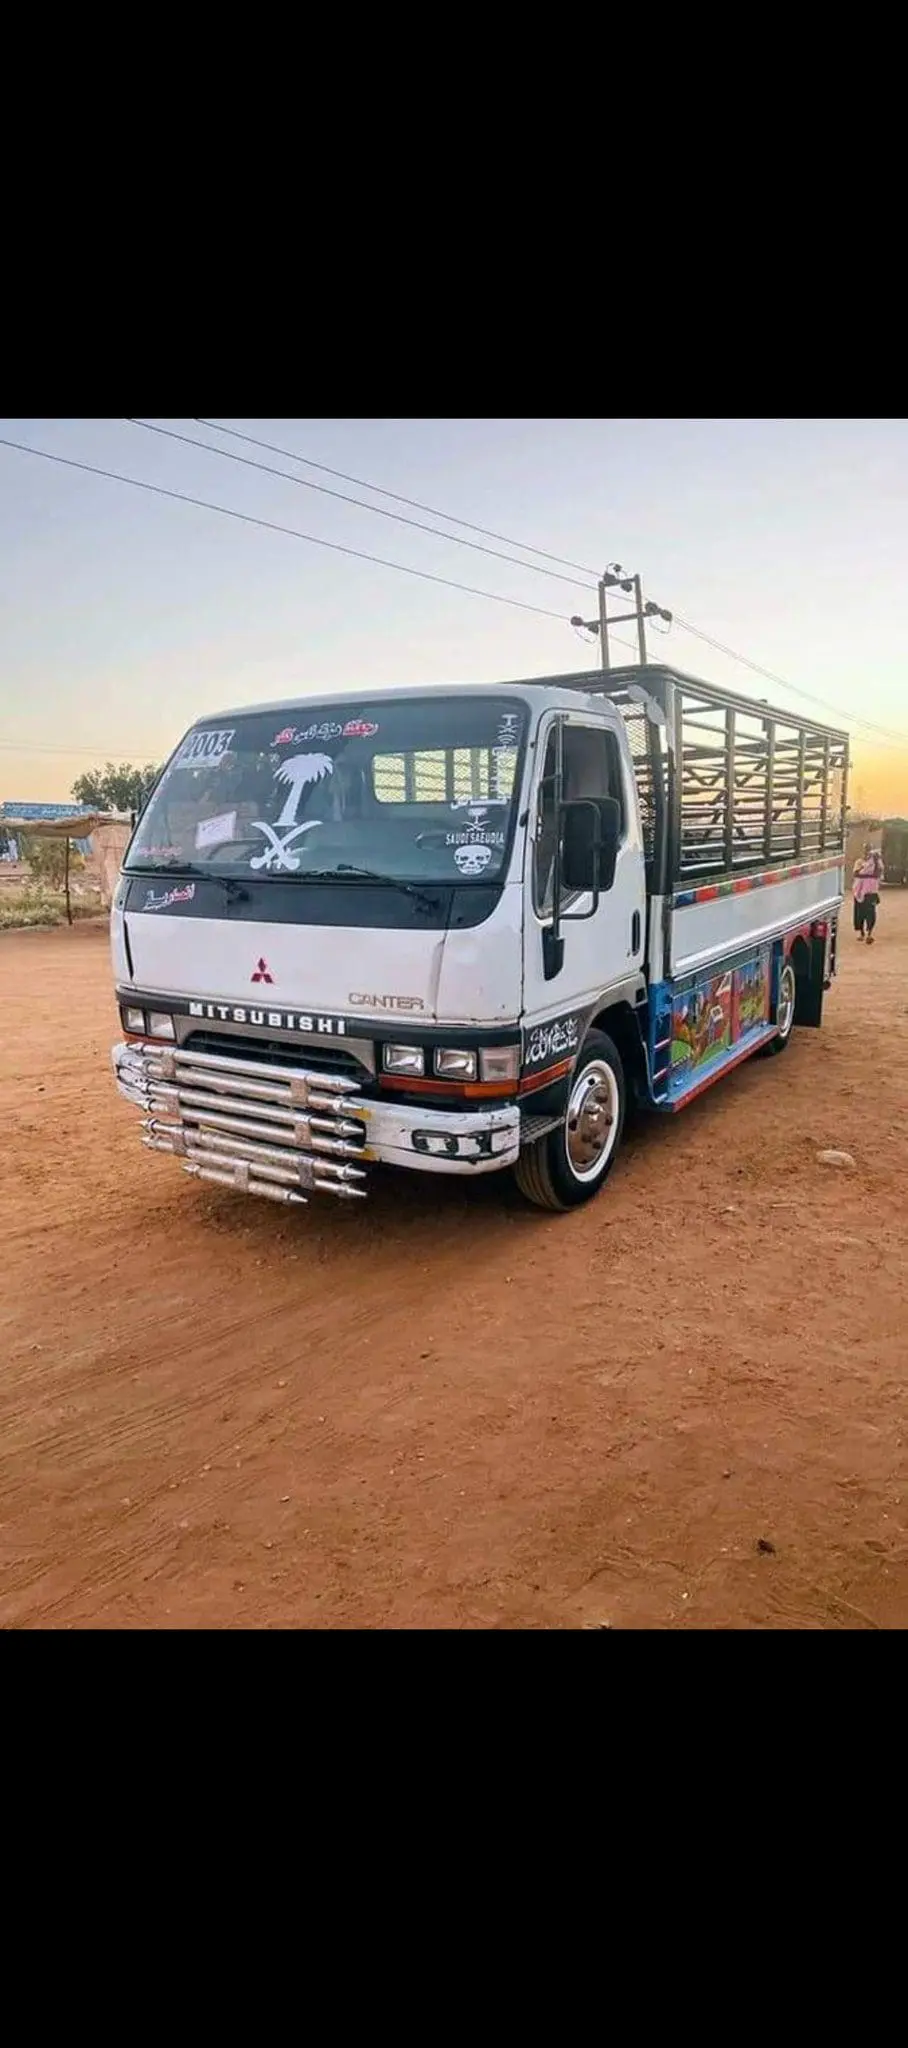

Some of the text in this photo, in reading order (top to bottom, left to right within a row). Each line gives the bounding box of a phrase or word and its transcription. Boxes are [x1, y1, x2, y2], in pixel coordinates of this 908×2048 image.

[183, 732, 232, 759] 2003
[446, 833, 469, 846] SAUDI
[348, 992, 425, 1010] CANTER
[188, 1001, 346, 1035] MITSUBISHI
